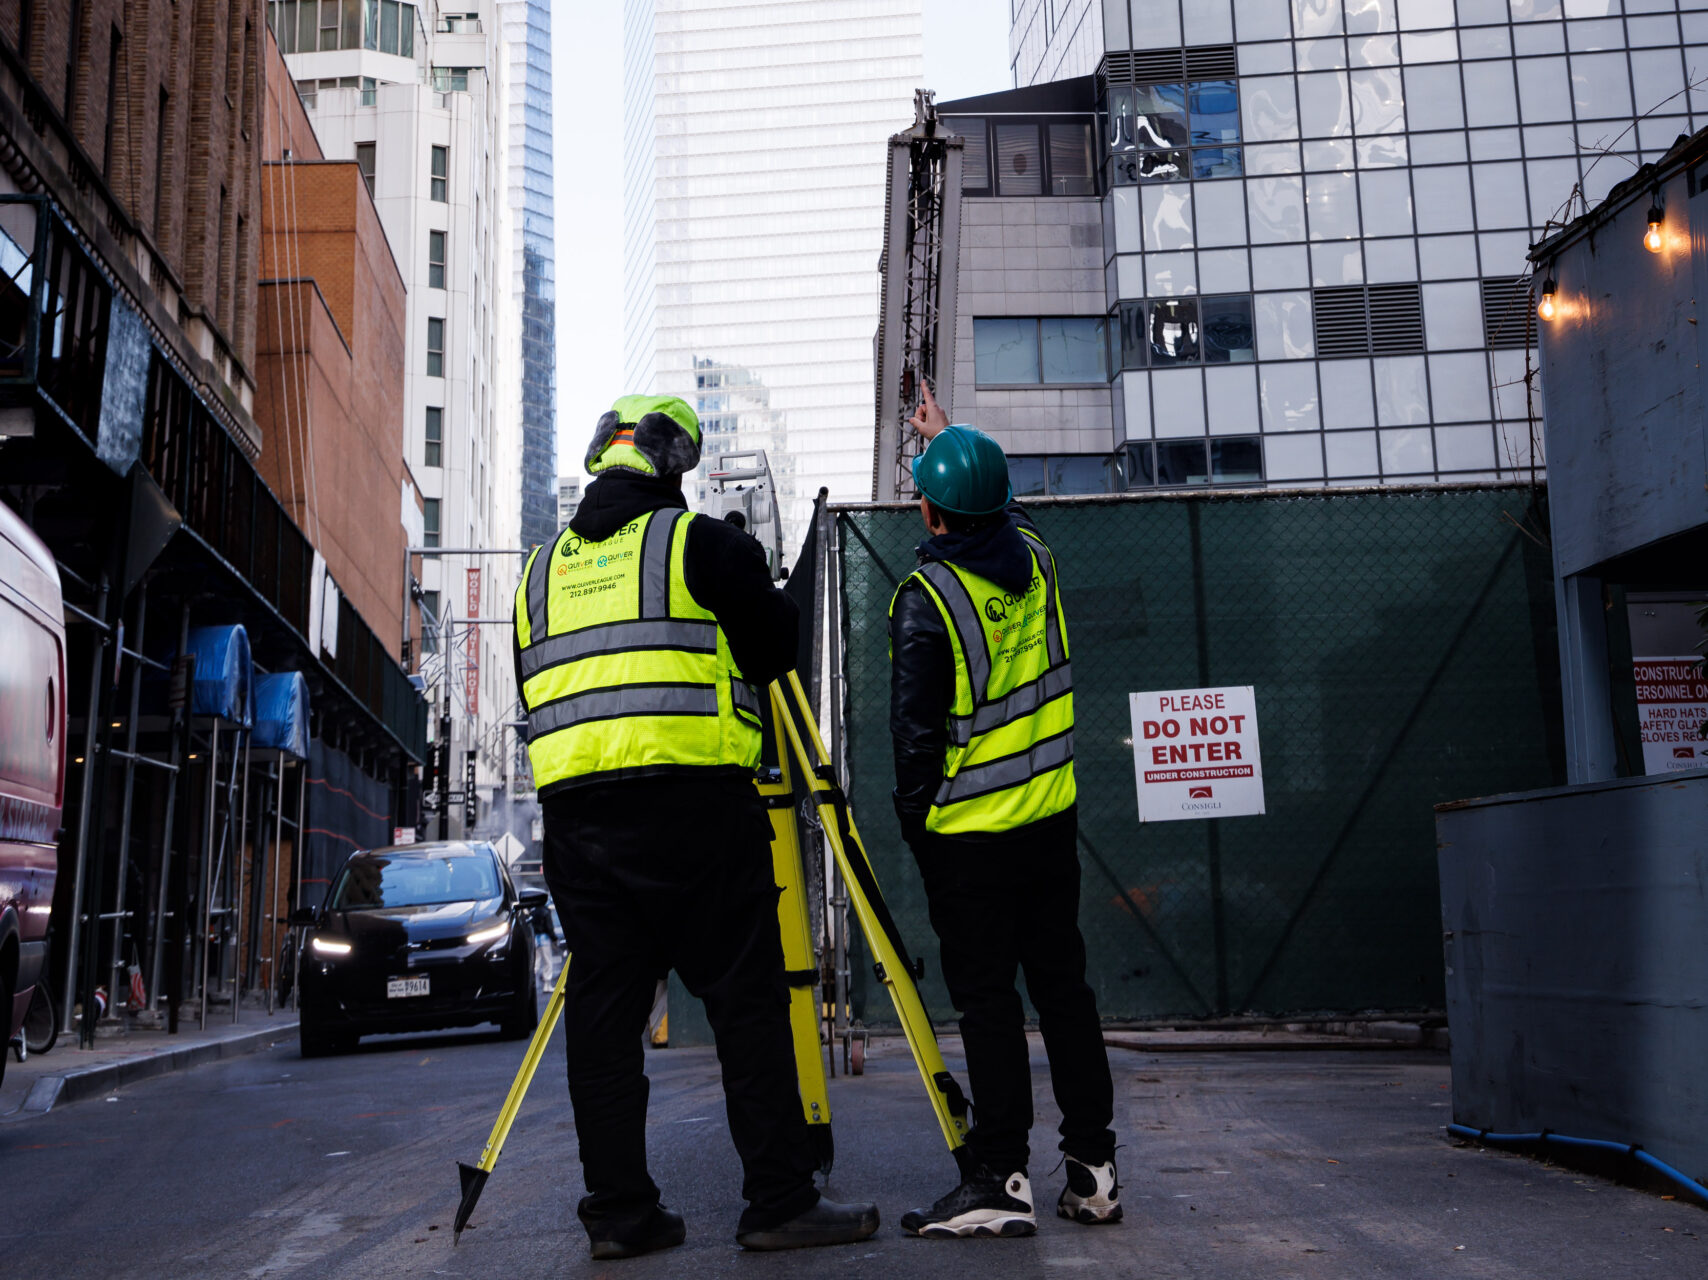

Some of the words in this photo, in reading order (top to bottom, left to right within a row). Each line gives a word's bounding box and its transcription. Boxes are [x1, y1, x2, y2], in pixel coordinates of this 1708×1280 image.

[592, 537, 625, 550] LEAGUE
[567, 559, 593, 570] QUIVER
[607, 551, 634, 561] QUIVER
[469, 572, 480, 611] WORLD
[569, 582, 617, 599] 212.897.9946
[1003, 576, 1041, 607] QUER
[468, 672, 478, 711] HOTEL
[1636, 683, 1694, 700] ERSONNEL
[1159, 693, 1226, 713] PLEASE
[1648, 708, 1678, 719] HARD
[1680, 707, 1707, 719] HATS
[1142, 718, 1181, 740] DO
[1189, 714, 1246, 737] NOT
[1151, 741, 1242, 766] ENTER
[1147, 772, 1179, 781] UNDER
[1180, 767, 1251, 779] CONSTRUCTION
[9, 799, 49, 842] STORAGE
